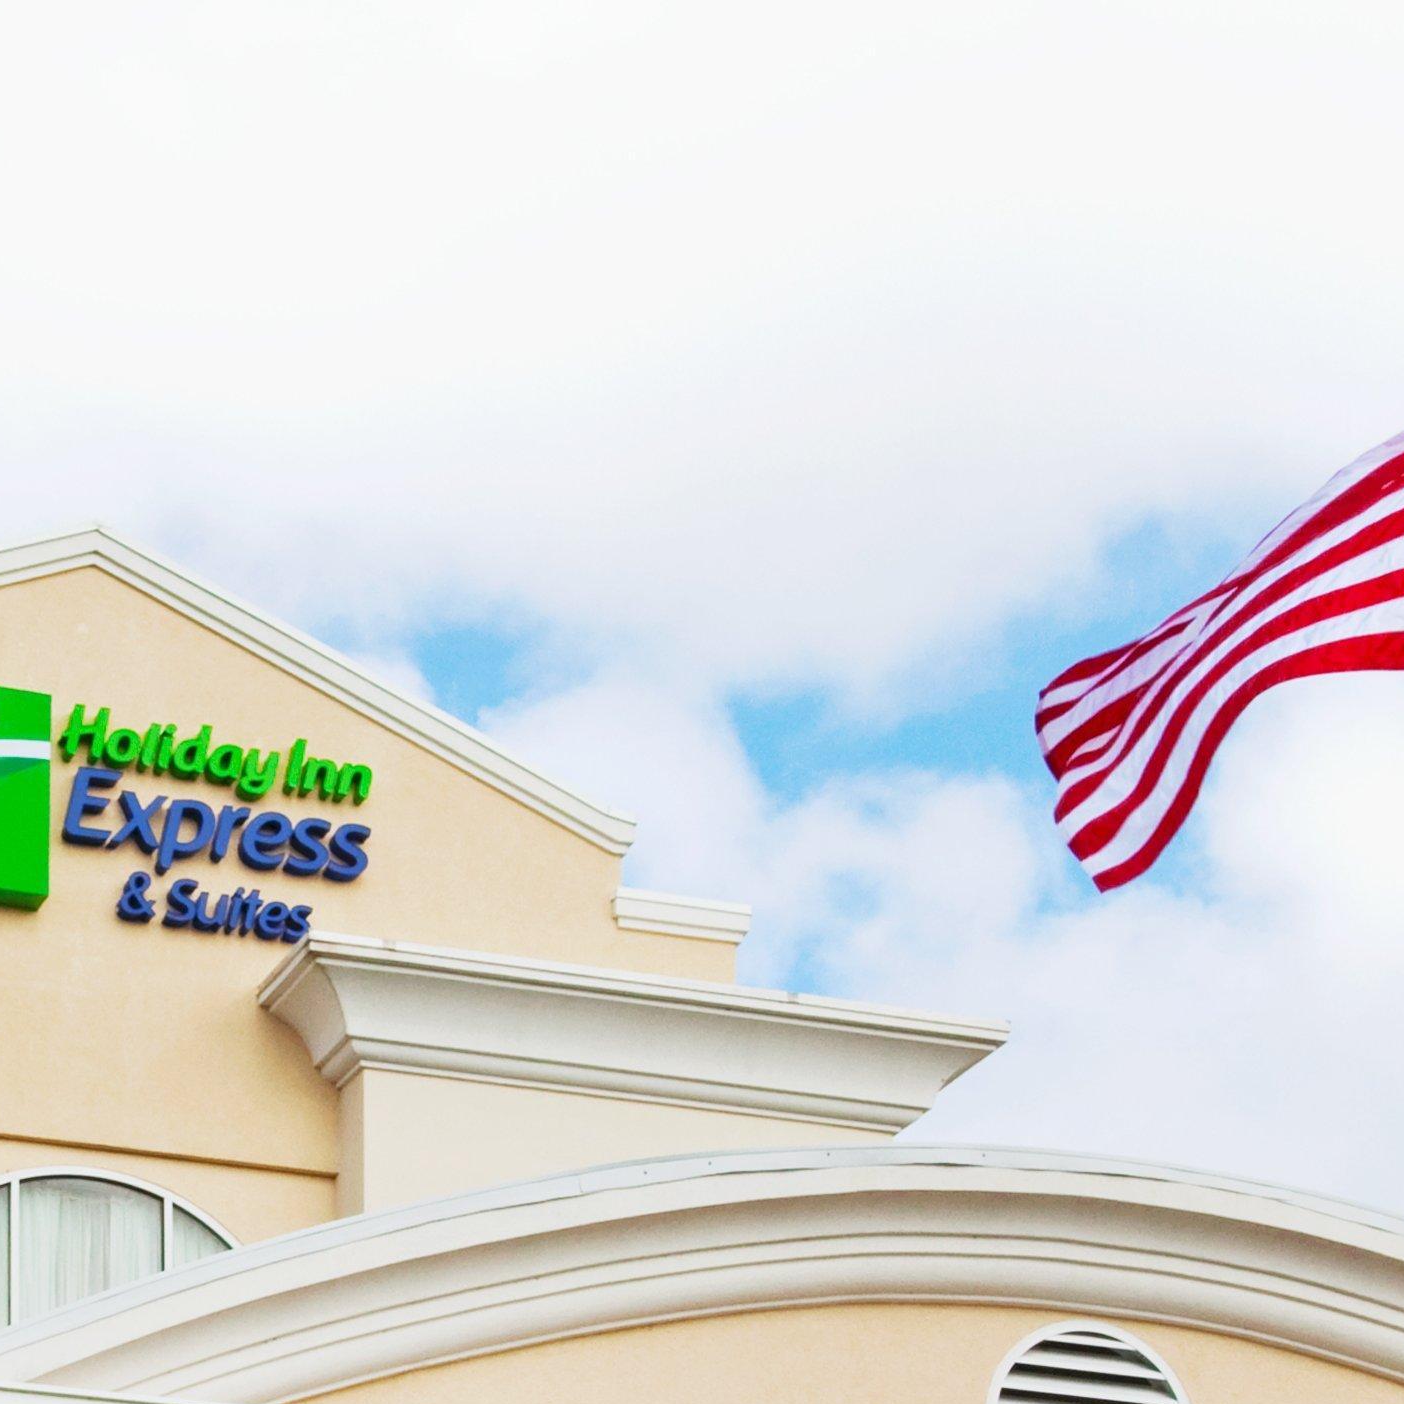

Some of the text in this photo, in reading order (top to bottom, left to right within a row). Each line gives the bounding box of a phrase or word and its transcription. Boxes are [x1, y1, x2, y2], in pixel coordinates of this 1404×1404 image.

[59, 703, 373, 806] Holiday Inn
[62, 766, 372, 882] Express
[116, 871, 313, 944] & Suites
